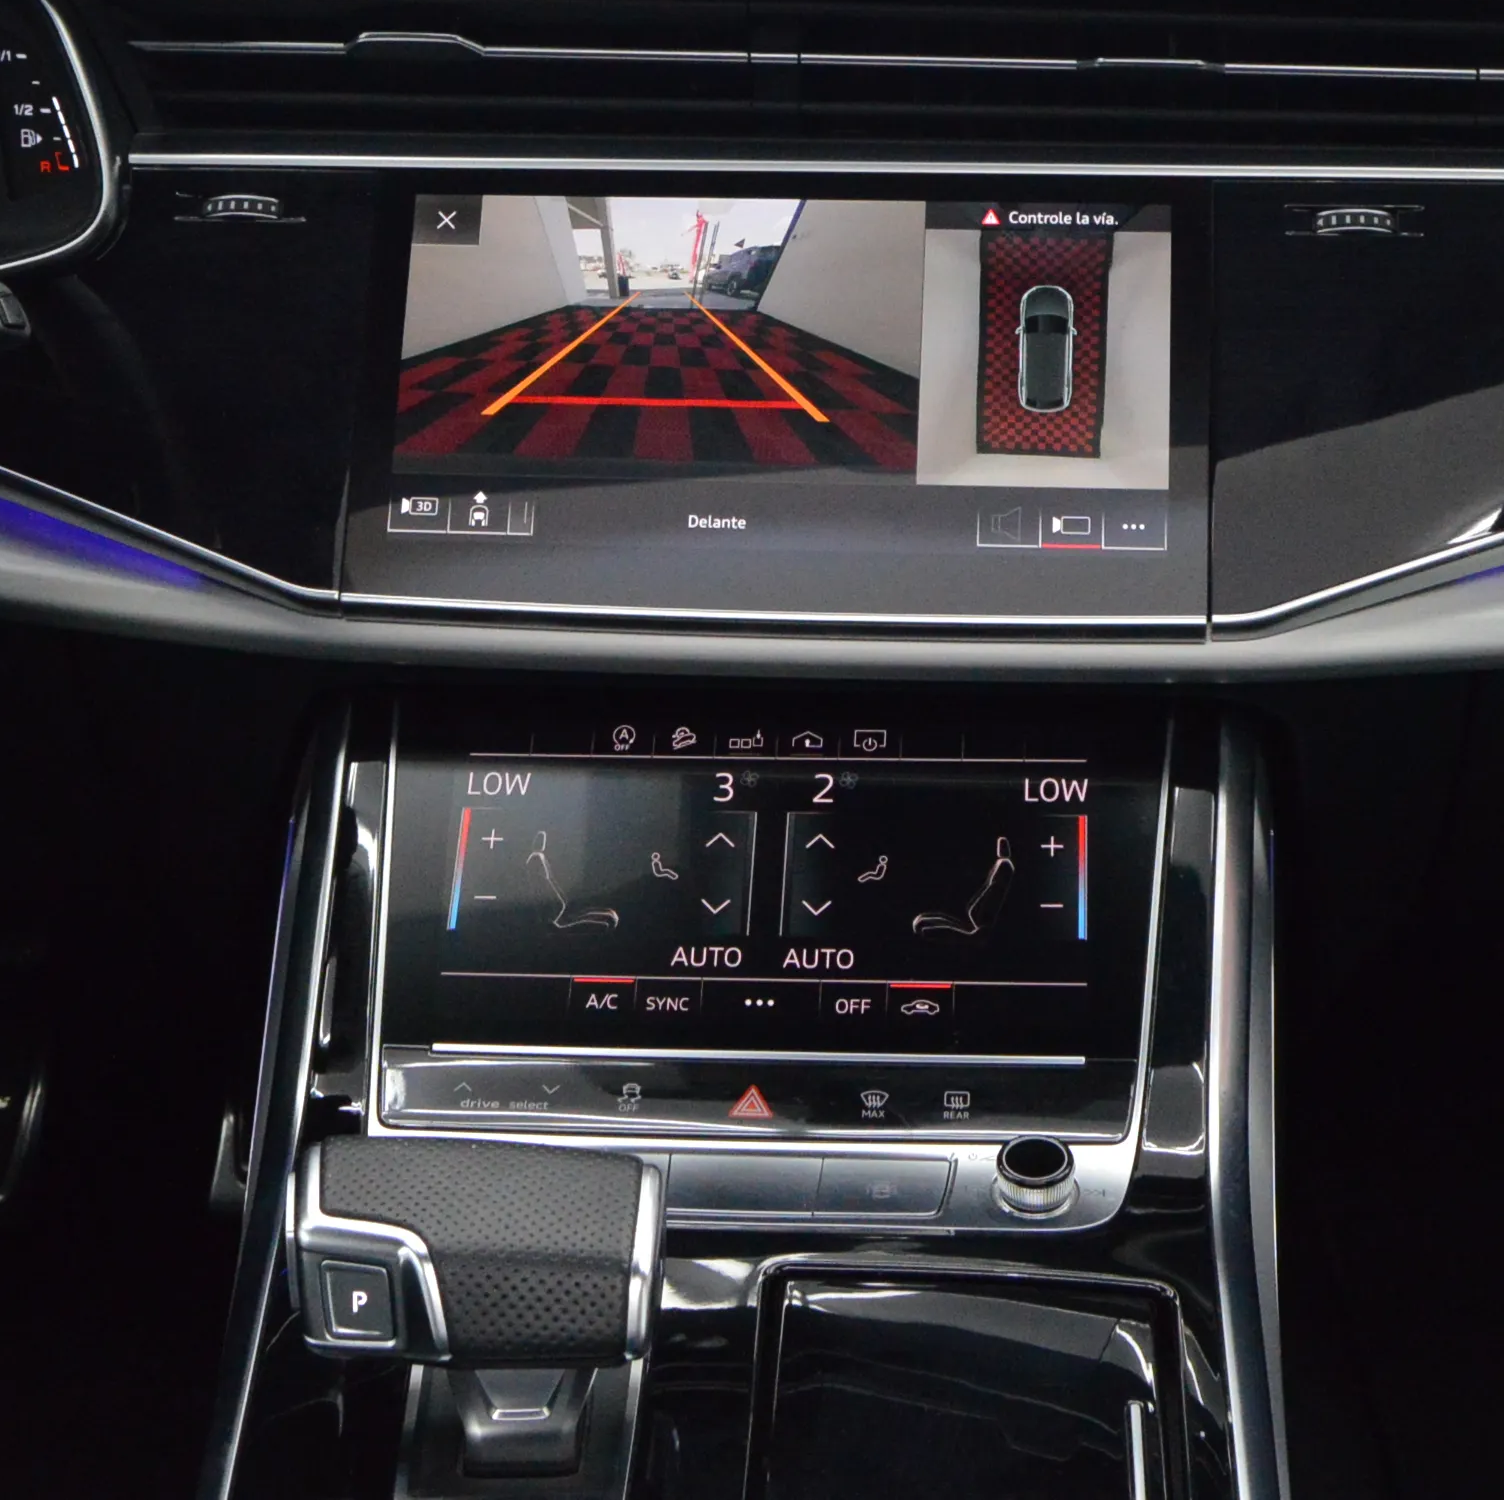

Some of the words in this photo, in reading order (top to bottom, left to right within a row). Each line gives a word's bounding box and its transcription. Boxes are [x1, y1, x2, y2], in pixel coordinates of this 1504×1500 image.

[14, 104, 33, 116] 1/2
[40, 161, 51, 172] R
[1009, 211, 1072, 224] Controle
[1076, 212, 1089, 225] la
[1093, 212, 1118, 225] vía.
[415, 501, 433, 513] 3D
[688, 515, 746, 529] Delante
[468, 772, 531, 795] LOW
[714, 773, 733, 801] 3
[813, 774, 833, 802] 2
[1025, 778, 1088, 802] LOW
[671, 947, 741, 967] AUTO
[783, 949, 853, 969] AUTO
[586, 994, 618, 1009] A/C
[647, 997, 689, 1011] SYNC
[836, 999, 871, 1014] OFF
[460, 1096, 501, 1110] drive
[508, 1097, 549, 1112] select
[619, 1102, 637, 1112] OFF
[862, 1107, 884, 1118] MAX
[943, 1108, 969, 1120] REAR
[352, 1291, 367, 1313] P
